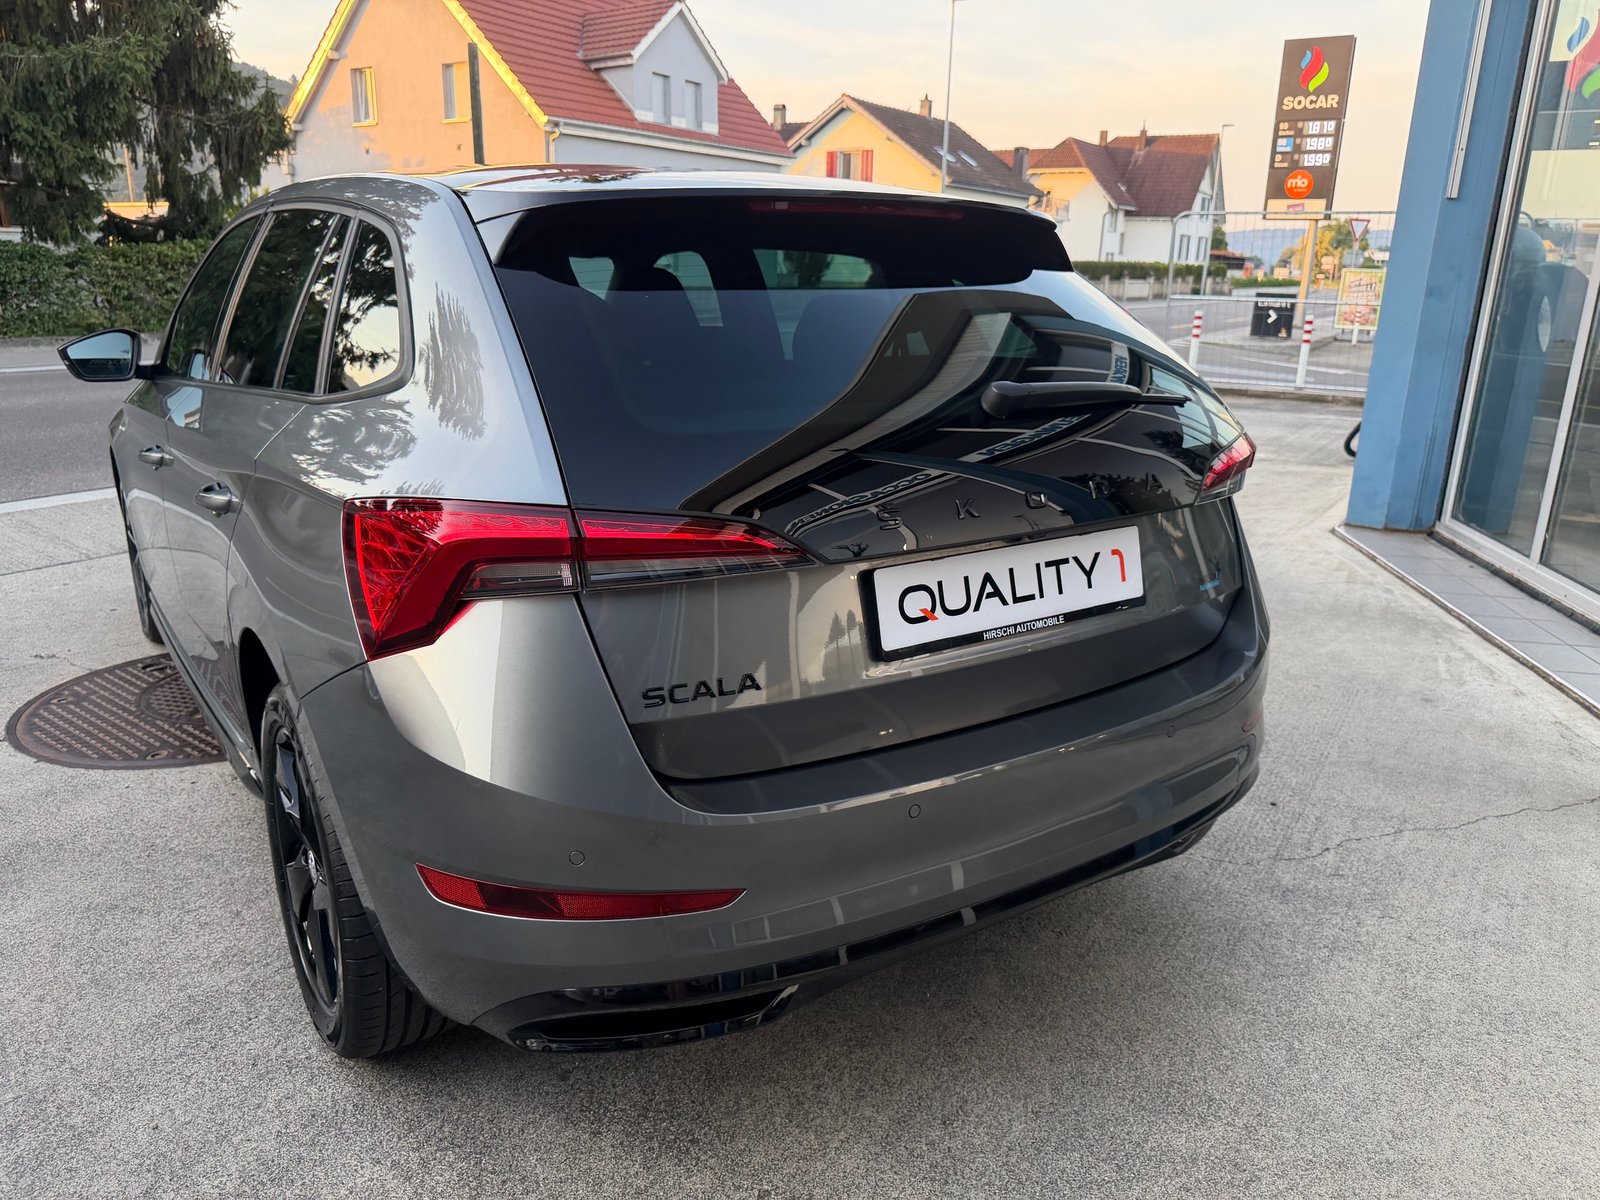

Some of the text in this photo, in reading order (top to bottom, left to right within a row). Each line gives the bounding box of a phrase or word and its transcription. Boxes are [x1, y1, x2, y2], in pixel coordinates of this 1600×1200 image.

[1282, 94, 1339, 110] SOCAR
[983, 615, 1065, 640] HIRSCHI AUTOMOBILE
[641, 672, 762, 709] SCALA
